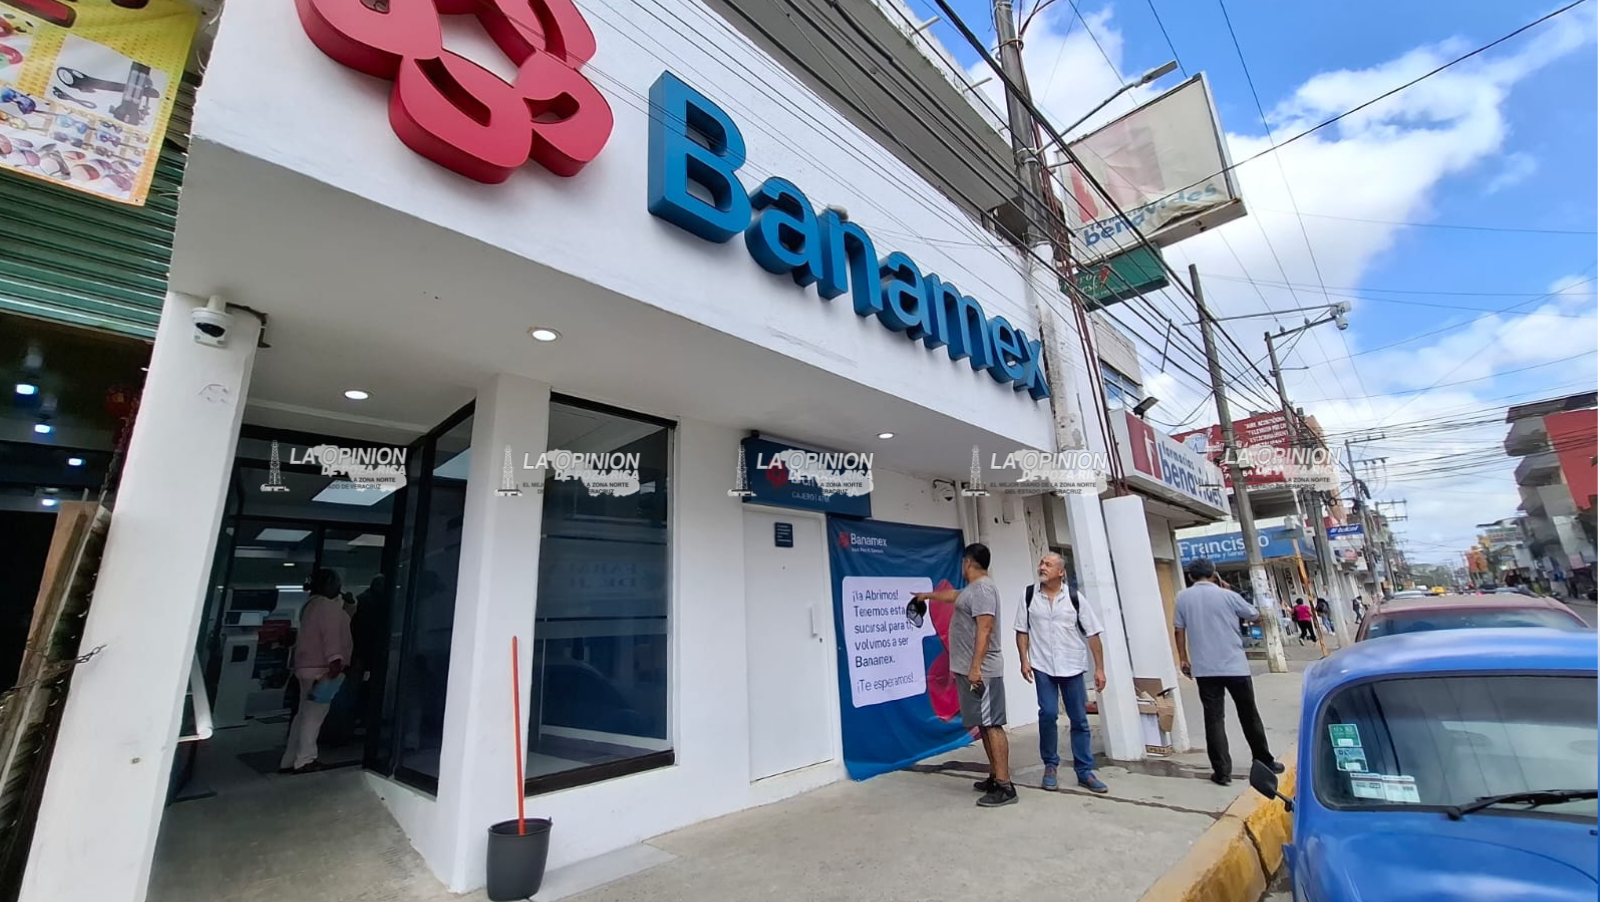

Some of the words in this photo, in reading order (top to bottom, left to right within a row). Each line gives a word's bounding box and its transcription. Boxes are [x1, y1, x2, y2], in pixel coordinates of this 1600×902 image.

[1083, 183, 1218, 247] benavides
[647, 69, 1050, 400] Banamex
[1161, 440, 1195, 471] farmacias
[1158, 442, 1224, 508] benavides
[850, 532, 888, 548] Banamex
[1177, 535, 1270, 558] Franciso
[865, 589, 899, 601] Abrimos!
[853, 605, 889, 618] Tenemos
[890, 606, 906, 615] esta
[854, 621, 887, 634] sucursal
[888, 622, 905, 634] para
[892, 639, 897, 647] a
[898, 636, 909, 646] ser
[855, 655, 895, 668] Banamex.
[857, 678, 872, 693] ¡Te
[873, 671, 914, 691] esperamos!
